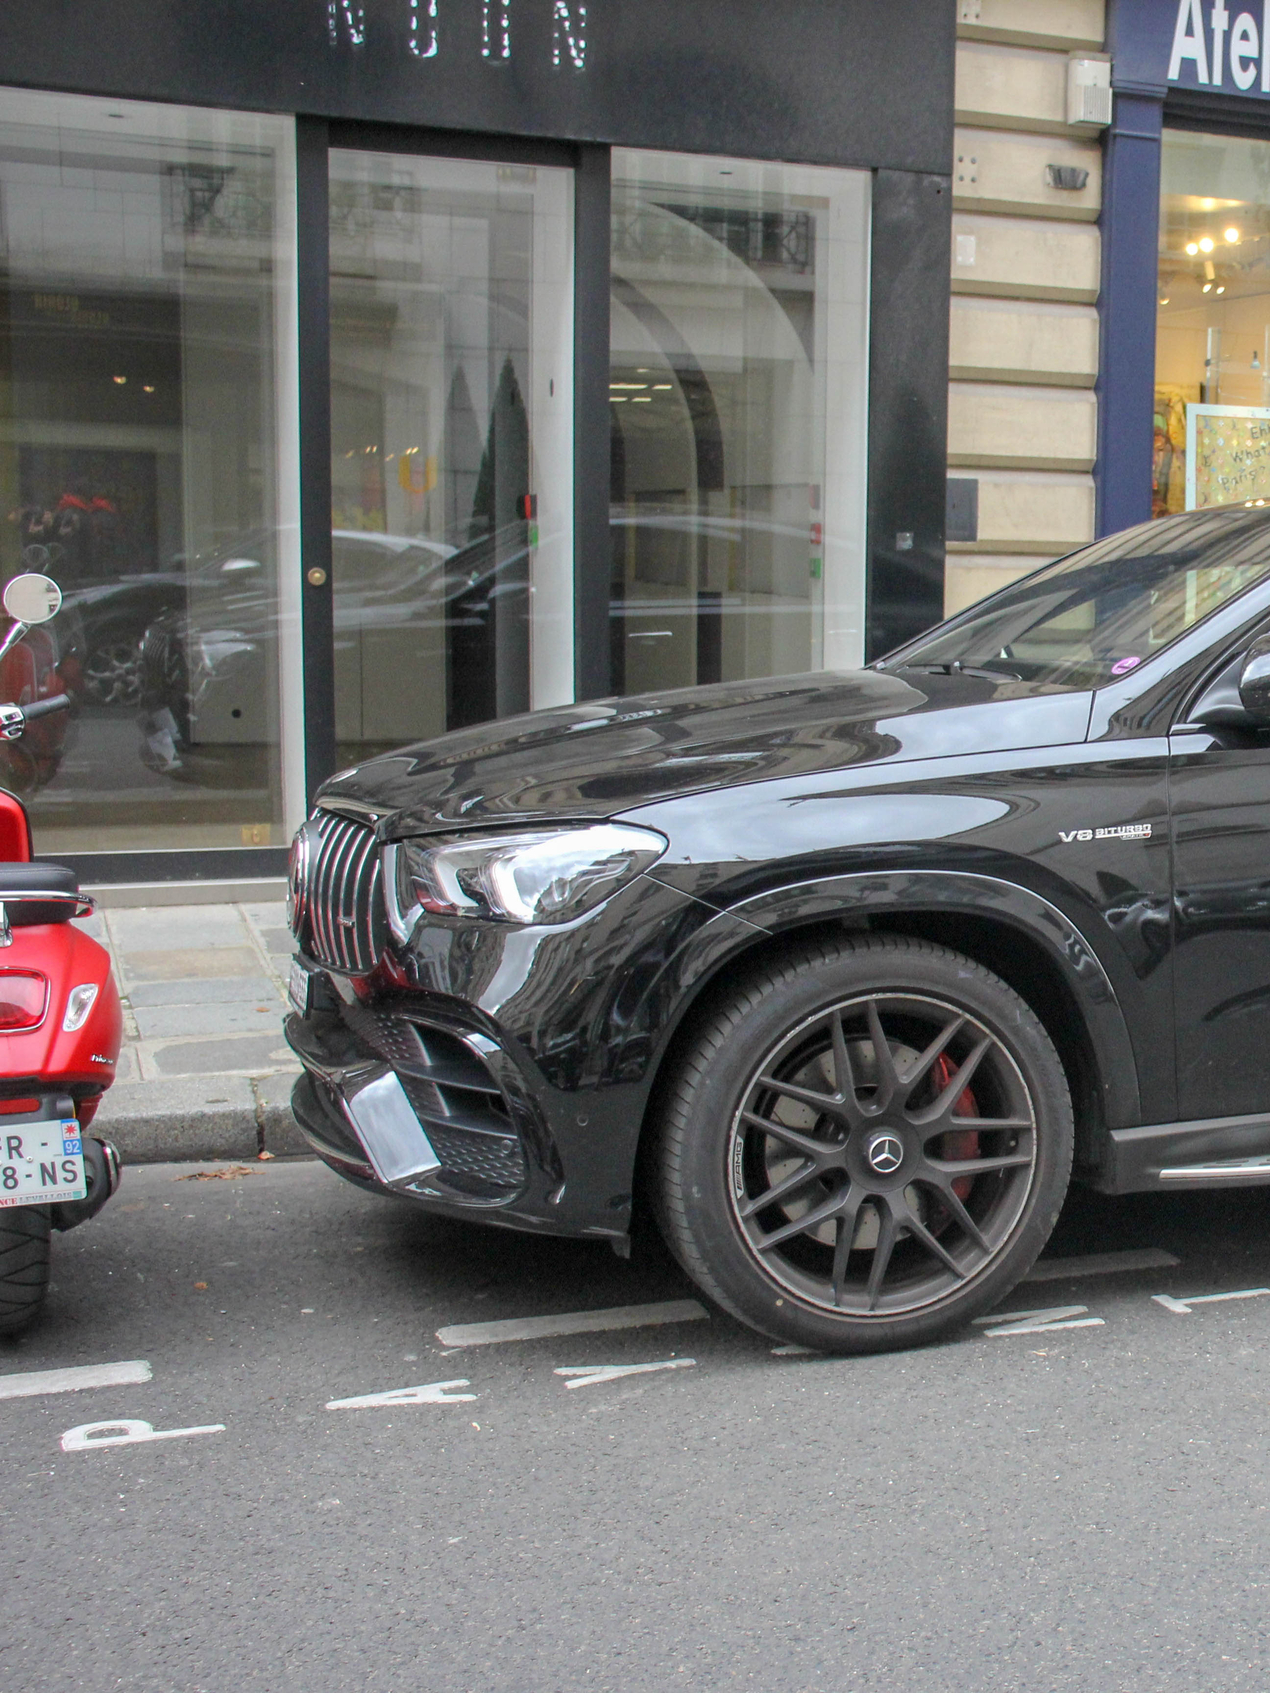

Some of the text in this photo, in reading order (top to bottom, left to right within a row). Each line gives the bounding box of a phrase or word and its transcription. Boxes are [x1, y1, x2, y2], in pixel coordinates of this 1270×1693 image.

[1058, 829, 1093, 842] V8
[1095, 823, 1152, 837] BITURBO
[65, 1140, 80, 1154] 92
